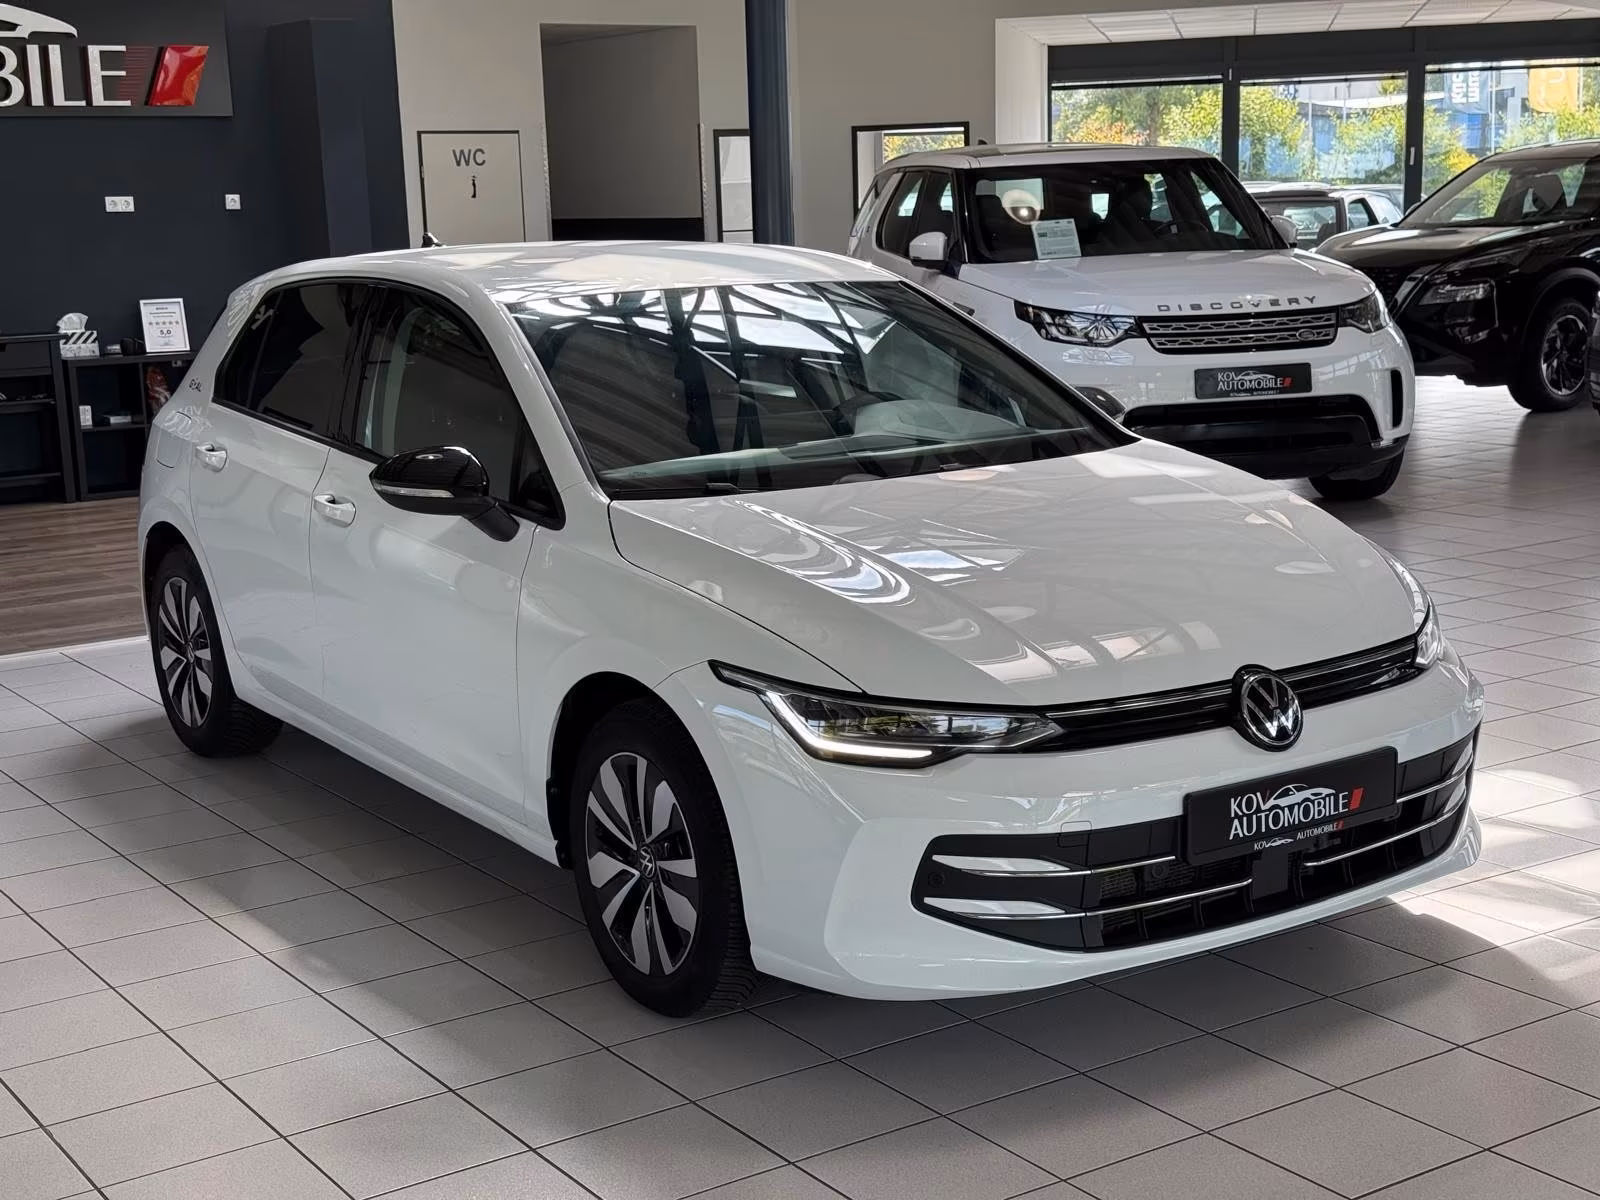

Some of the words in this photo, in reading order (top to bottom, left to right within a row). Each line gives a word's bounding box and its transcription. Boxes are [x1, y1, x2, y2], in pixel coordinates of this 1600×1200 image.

[452, 148, 486, 167] WC
[1157, 296, 1316, 312] DISCOVERY
[1217, 377, 1283, 391] AUTOMOBILE
[1230, 790, 1270, 818] KOV
[1229, 791, 1349, 840] AUTOMOBILE
[1296, 822, 1338, 841] AUTOMOBILE
